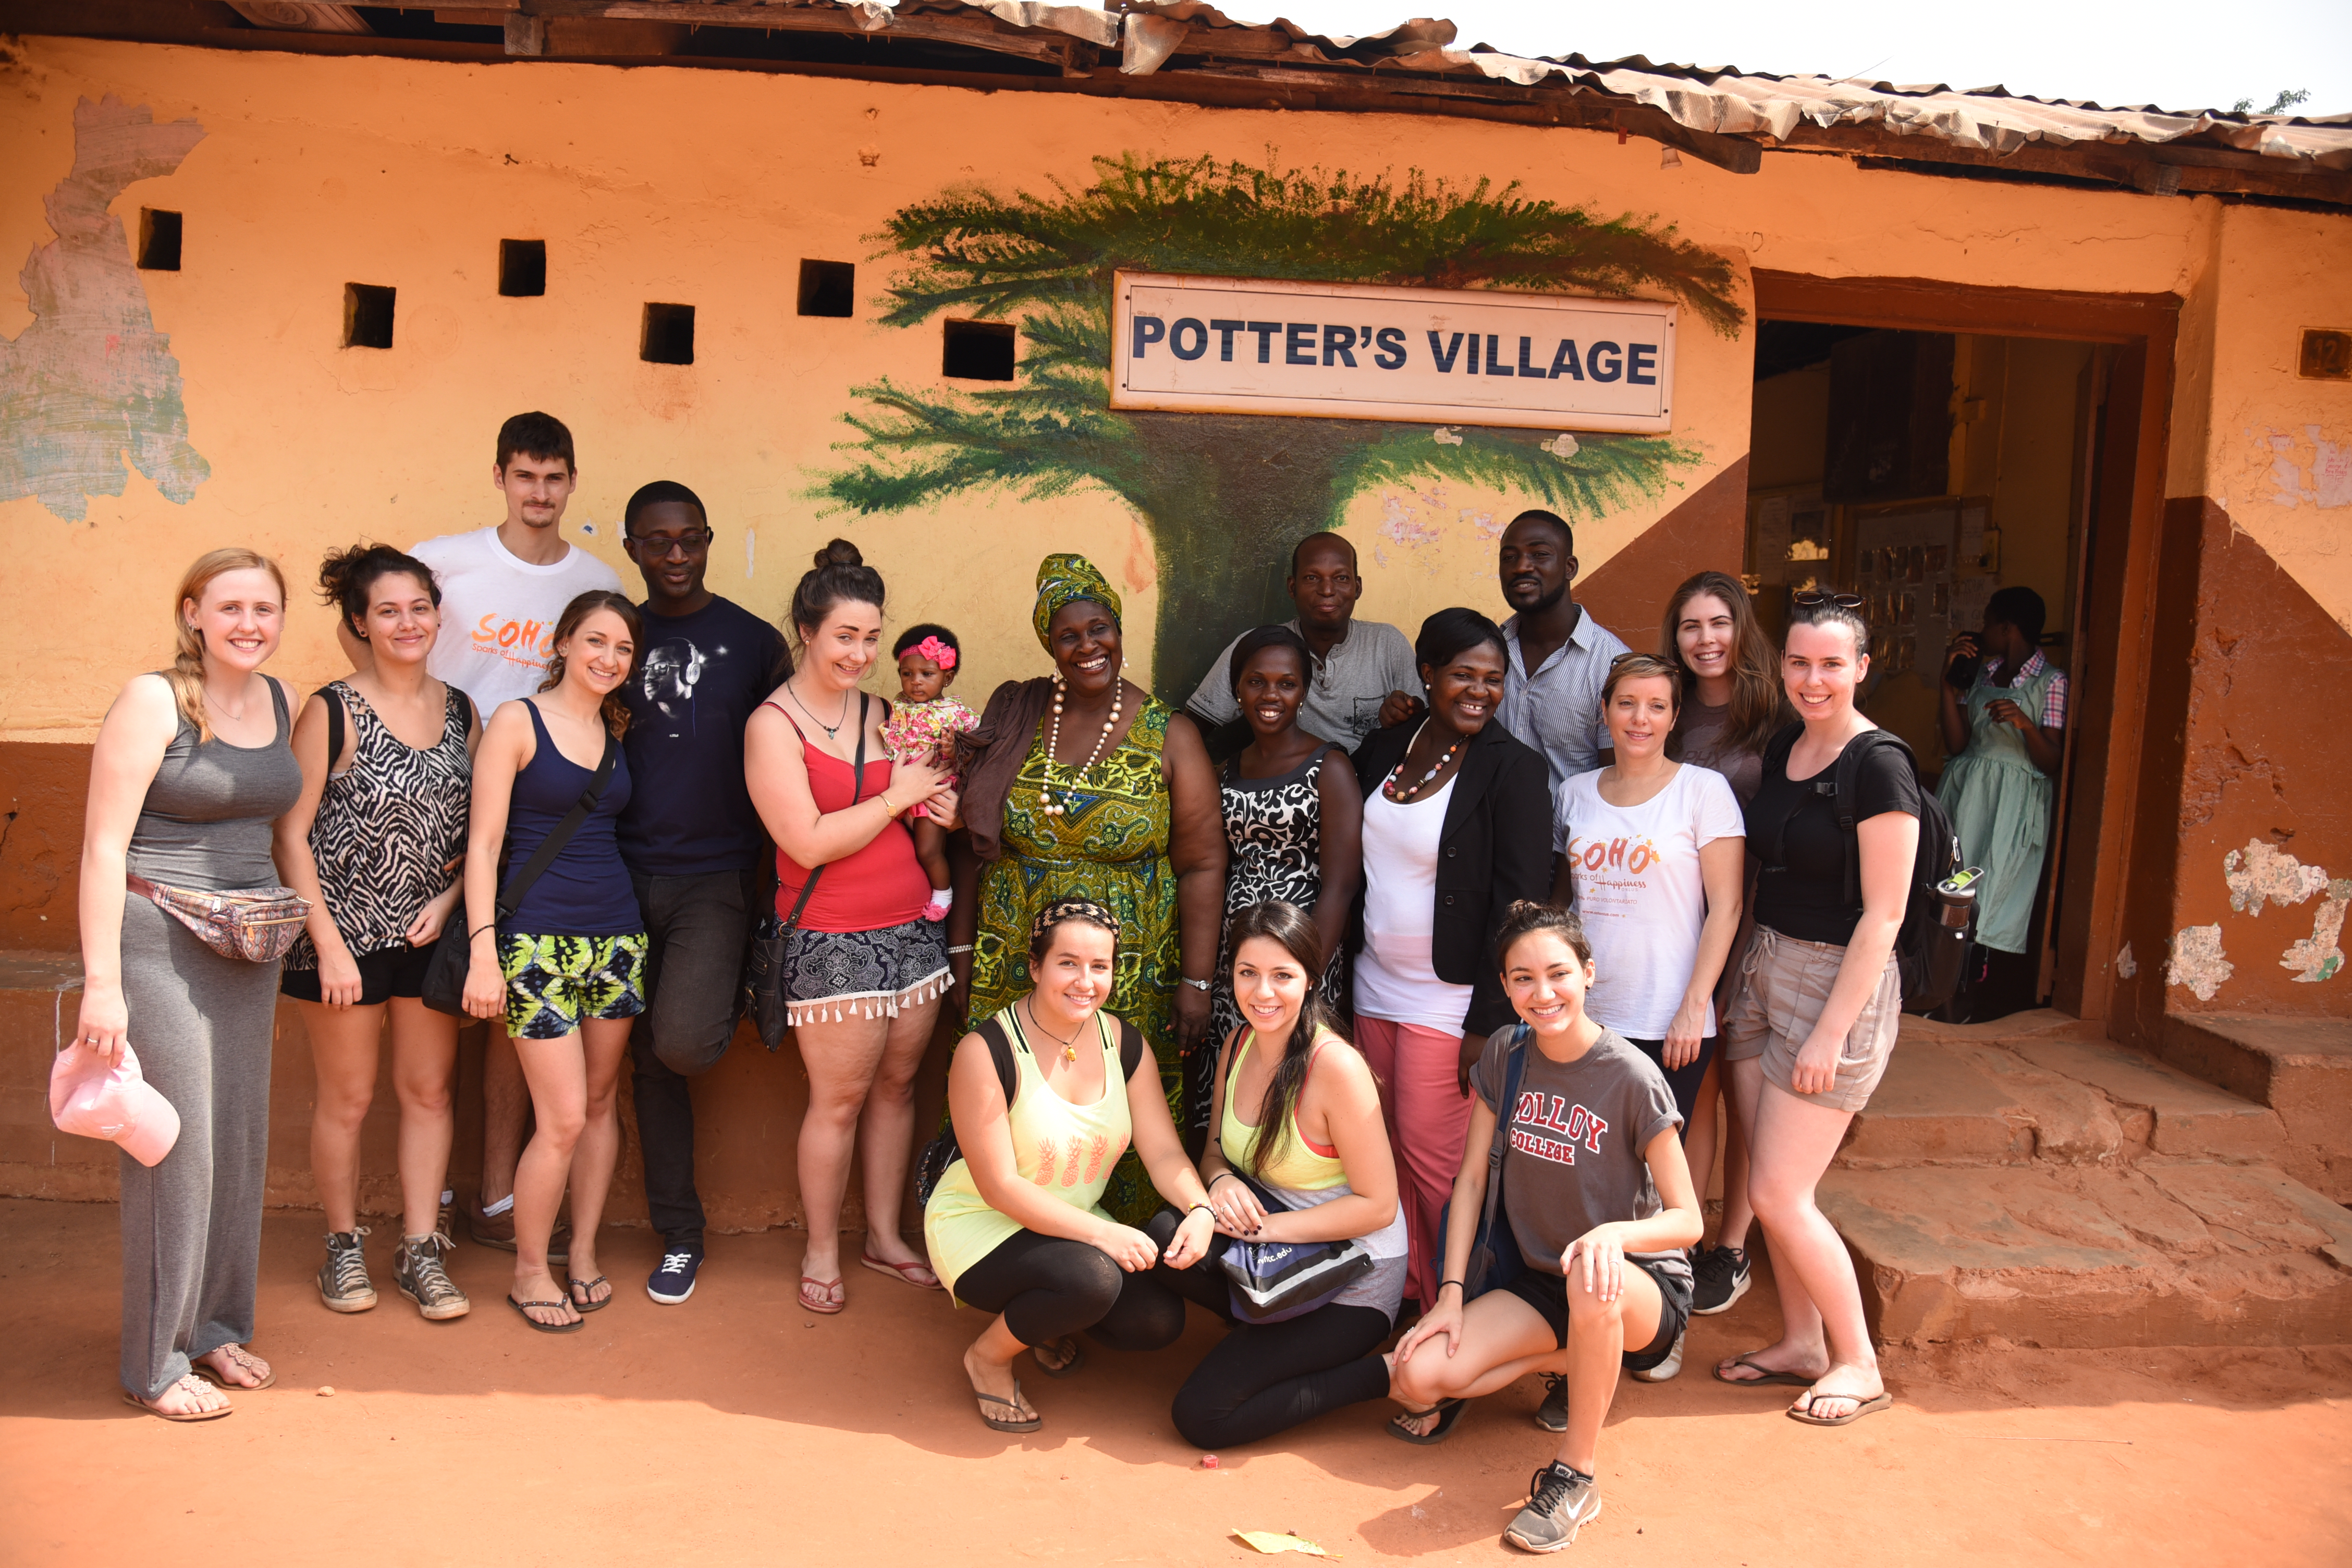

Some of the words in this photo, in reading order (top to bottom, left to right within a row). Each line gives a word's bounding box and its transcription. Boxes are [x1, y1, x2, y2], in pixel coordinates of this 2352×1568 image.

[1132, 316, 1407, 370] POTTER'S
[1427, 330, 1658, 386] VILLAGE
[472, 643, 498, 655] Sparks
[1567, 836, 1650, 874] SOHO
[1571, 872, 1587, 881] parks
[1594, 875, 1647, 891] Happiness
[1510, 1128, 1575, 1166] COLLEGE
[1556, 1467, 1570, 1477] NIKE
